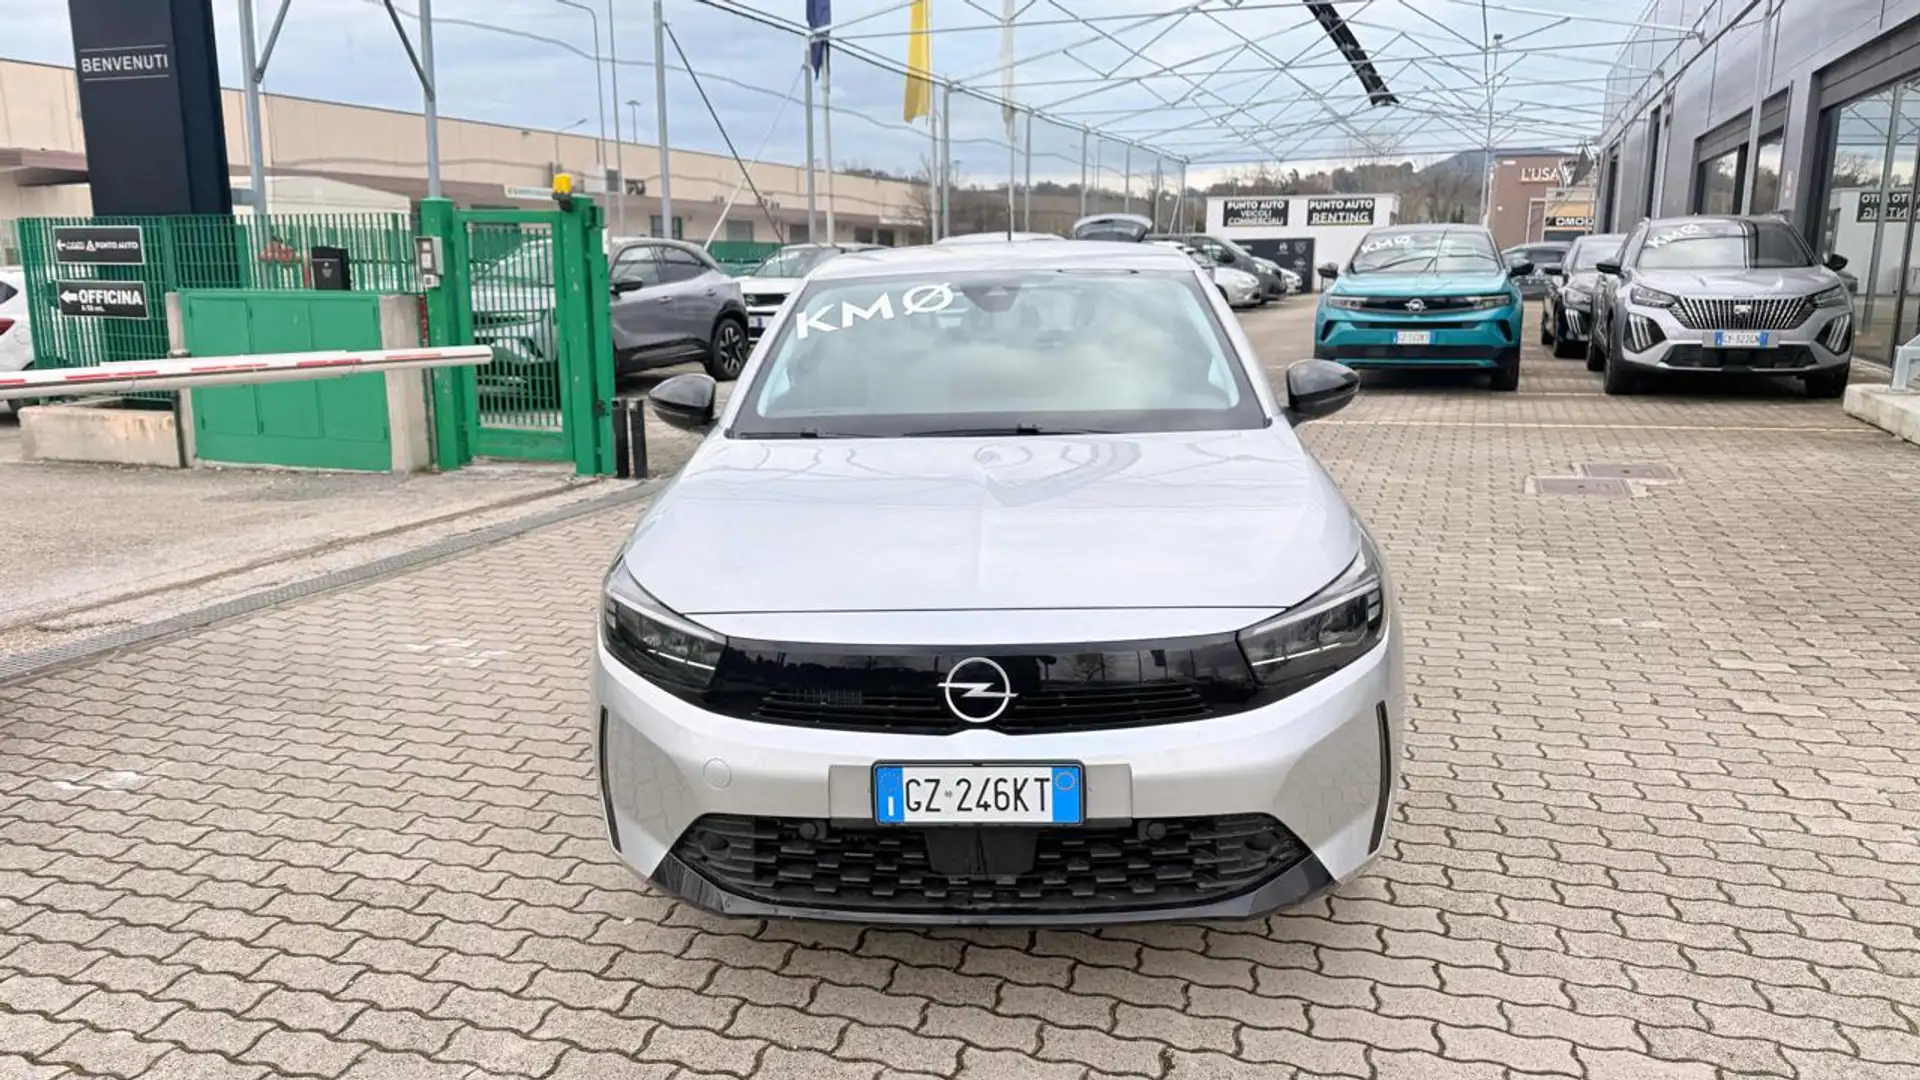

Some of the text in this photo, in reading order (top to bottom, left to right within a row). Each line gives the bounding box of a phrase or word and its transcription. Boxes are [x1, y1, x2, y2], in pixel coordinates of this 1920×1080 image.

[81, 53, 169, 73] BENVENUTI
[1227, 200, 1285, 210] PUNTO AUTO
[1309, 199, 1374, 210] PUNTO AUTO
[1240, 209, 1272, 217] VEICOLI
[1312, 211, 1370, 223] RENTING
[1227, 216, 1284, 225] COMMERCIALI
[79, 289, 144, 305] OFFICINA
[905, 777, 1051, 812] GZ 246KT
